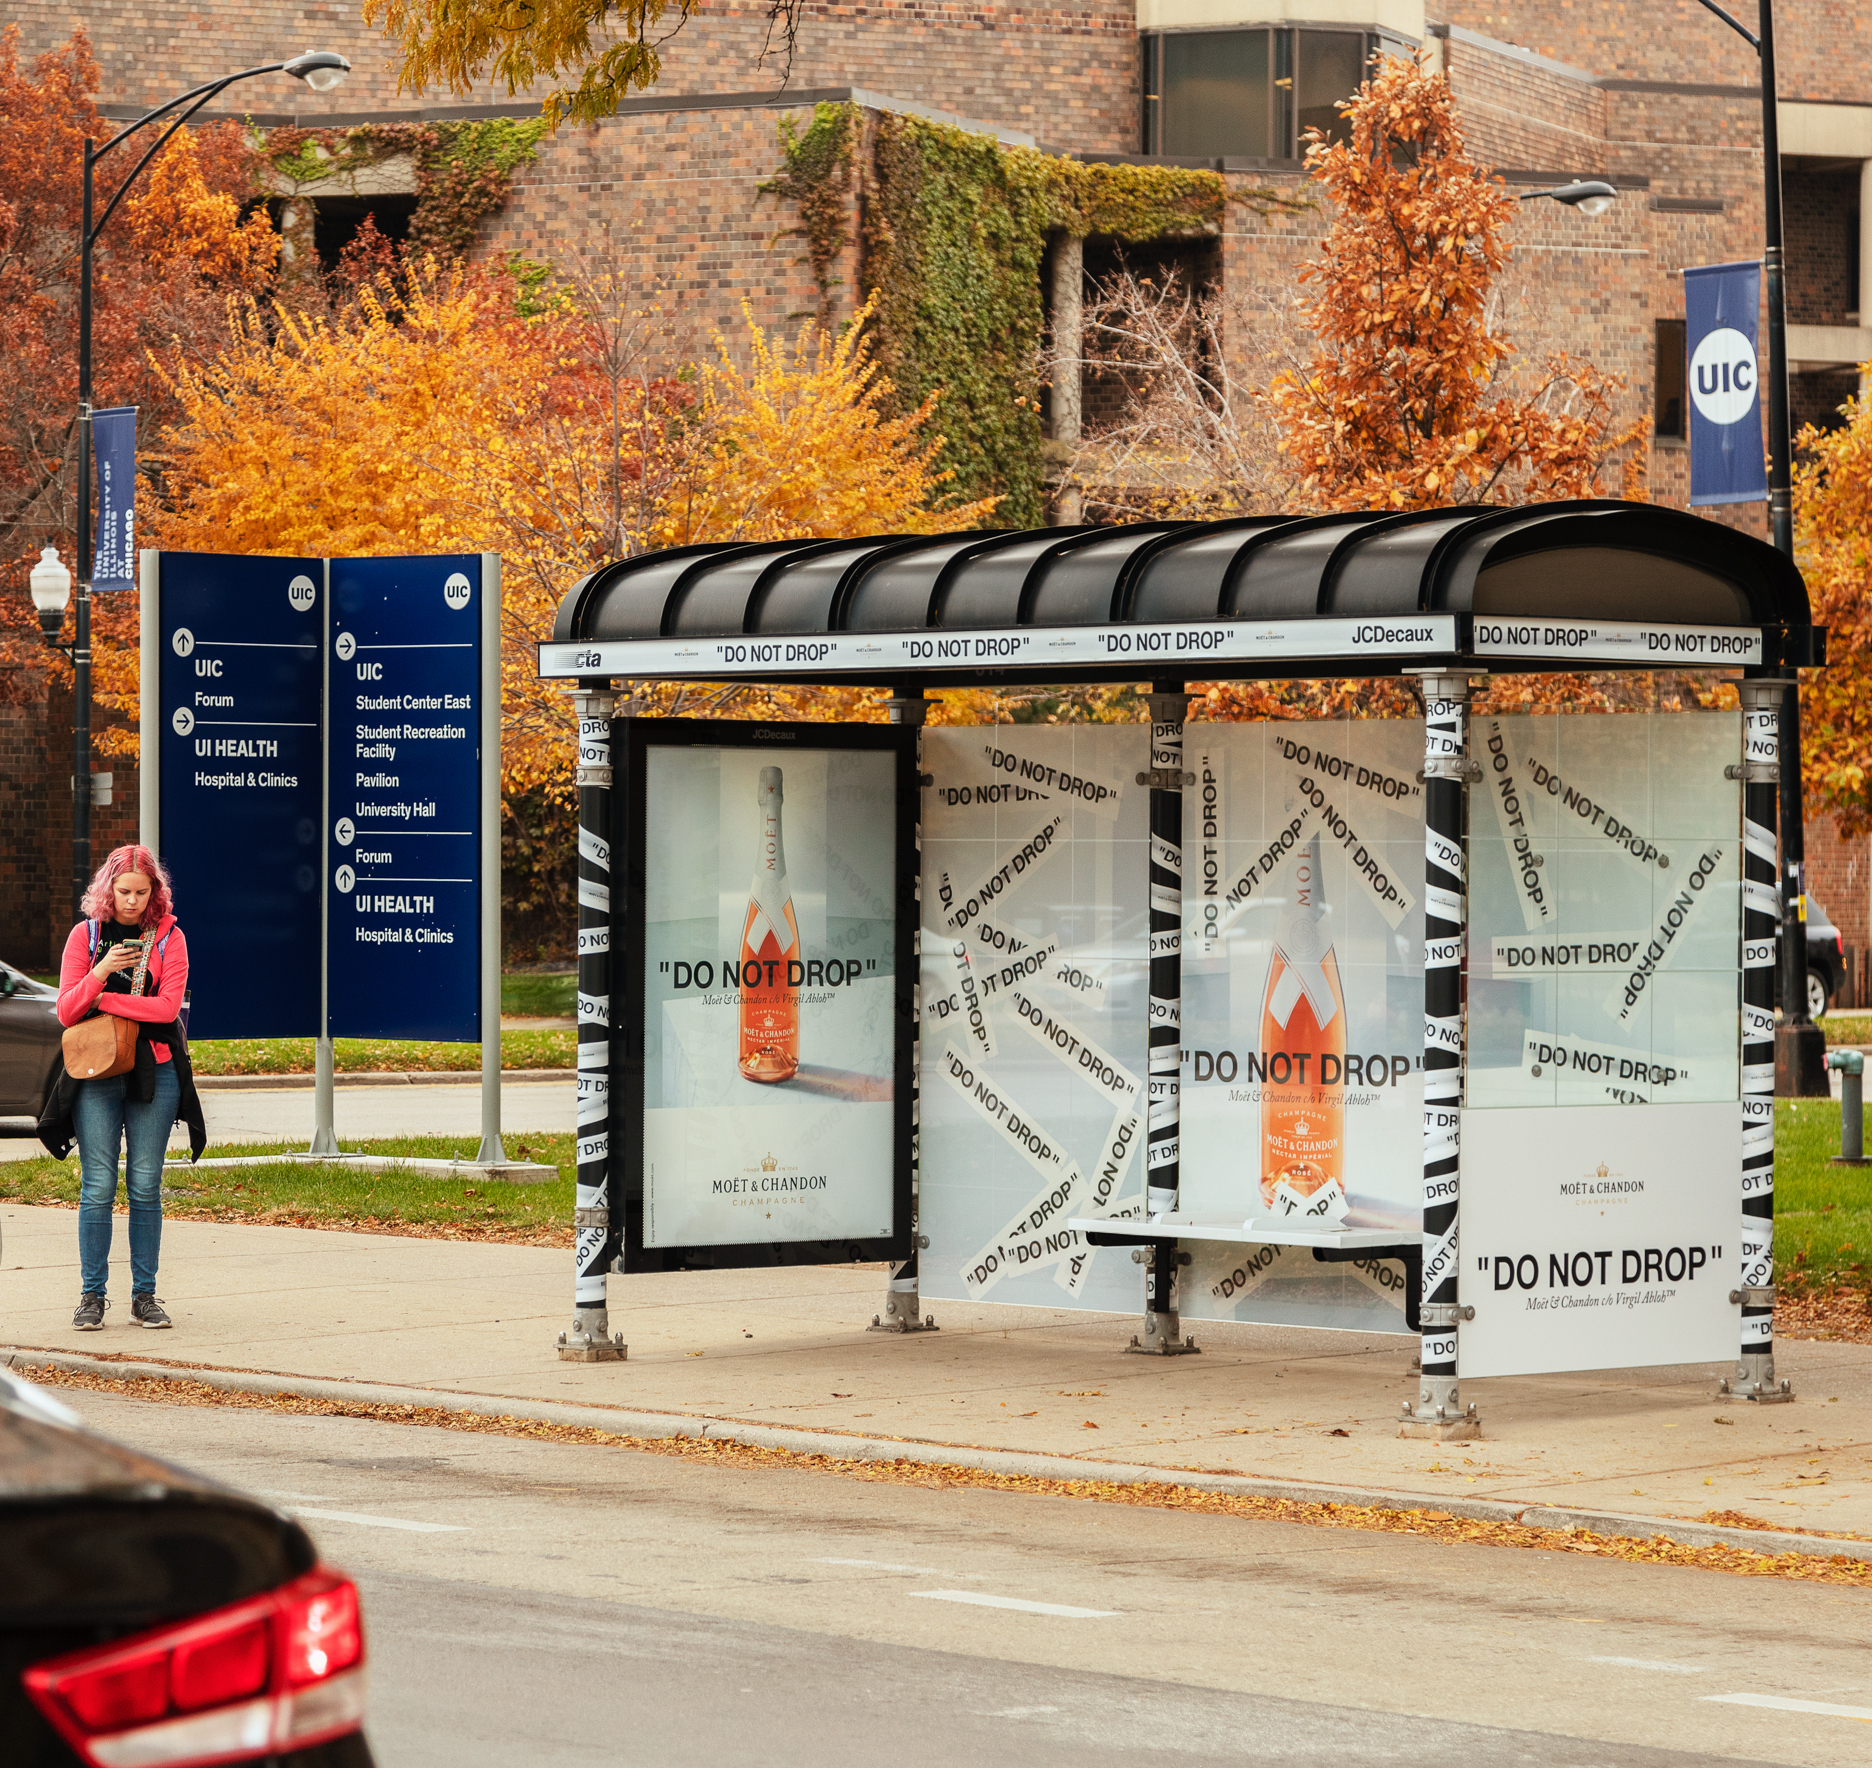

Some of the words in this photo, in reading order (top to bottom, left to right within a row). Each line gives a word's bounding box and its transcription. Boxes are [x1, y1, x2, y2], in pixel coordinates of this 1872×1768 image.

[1697, 360, 1752, 395] UIC
[104, 461, 111, 481] OF
[102, 485, 111, 579] UNIVERSITY
[125, 509, 134, 580] CHICAGO
[94, 550, 103, 580] THE
[117, 559, 124, 578] AT
[291, 587, 313, 600] UIC
[447, 585, 468, 598] UIC
[1098, 634, 1131, 652] "DO
[1137, 632, 1171, 651] NOT
[1176, 630, 1234, 650] DROP"
[1352, 625, 1434, 644] JCDecaux
[1507, 626, 1540, 645] NOT
[1544, 628, 1597, 647] DROP"
[1640, 632, 1671, 651] "DO
[1675, 634, 1706, 652] NOT
[1711, 635, 1760, 654] DROP"
[717, 645, 747, 662] "DO
[751, 644, 782, 662] NOT
[786, 643, 837, 661] DROP"
[902, 640, 933, 658] "DO
[938, 639, 971, 657] NOT
[975, 637, 1029, 656] DROP"
[195, 659, 223, 677] UIC
[356, 662, 383, 681] UIC
[195, 692, 234, 707] Forum
[356, 695, 401, 710] Student
[403, 695, 442, 710] Center
[444, 694, 471, 709] East
[356, 725, 401, 740] Student
[403, 724, 465, 739] Recreation
[752, 729, 796, 740] JCDecaux
[195, 738, 211, 757] UI
[215, 739, 278, 758] HEALTH
[356, 743, 396, 761] Facility
[985, 745, 1016, 773] "DO
[1020, 759, 1057, 786] NOT
[1058, 772, 1117, 803] DROP"
[1276, 736, 1311, 765] "DO
[1314, 751, 1354, 780] NOT
[1356, 766, 1420, 800] DROP"
[195, 771, 244, 790] Hospital
[247, 773, 256, 786] &
[258, 772, 298, 788] Clinics
[356, 773, 399, 787] Pavilion
[938, 786, 972, 806] "DO
[976, 784, 1011, 804] NOT
[1202, 756, 1217, 838] DROP"
[1528, 757, 1562, 796] "DO
[1562, 786, 1605, 826] NOT
[356, 802, 411, 820] University
[413, 802, 436, 816] Hall
[1487, 721, 1508, 773] "DO
[1498, 777, 1525, 829] NOT
[1513, 834, 1548, 917] DROP"
[765, 815, 777, 871] MOËT
[356, 848, 392, 863] Forum
[1225, 866, 1262, 911] NOT
[1258, 808, 1309, 874] DROP"
[1321, 804, 1358, 850] NOT
[1352, 846, 1406, 909] DROP"
[947, 898, 979, 928] "DO
[979, 865, 1012, 906] NOT
[1011, 816, 1061, 874] DROP"
[1203, 844, 1218, 896] NOT
[1688, 849, 1723, 891] "DO
[356, 895, 371, 912] UI
[374, 896, 434, 913] HEALTH
[1204, 903, 1219, 952] "DO
[1659, 891, 1694, 944] NOT
[356, 927, 402, 945] Hospital
[404, 928, 413, 942] &
[415, 928, 454, 943] Clinics
[1001, 945, 1055, 987] DROP"
[1496, 947, 1535, 967] "DO
[1542, 944, 1583, 966] NOT
[659, 960, 714, 989] "DO
[723, 960, 779, 988] NOT
[787, 959, 876, 988] DROP"
[1620, 940, 1665, 1020] DROP"
[702, 995, 721, 1005] Moët
[733, 993, 767, 1004] Chandon
[769, 994, 780, 1004] c/o
[782, 993, 804, 1007] Virgil
[752, 1009, 787, 1017] CHAMPAGNE
[960, 975, 991, 1053] DROP"
[765, 1027, 795, 1038] CHANDON
[1013, 992, 1043, 1027] "DO
[1043, 1018, 1080, 1056] NOT
[1078, 1047, 1134, 1093] DROP"
[1179, 1050, 1238, 1083] "DO
[1248, 1051, 1312, 1085] NOT
[1528, 1041, 1567, 1067] "DO
[1572, 1050, 1615, 1076] NOT
[1619, 1058, 1688, 1087] DROP"
[946, 1051, 974, 1088] "DO
[974, 1081, 1009, 1120] NOT
[1006, 1113, 1060, 1164] DROP"
[1228, 1089, 1251, 1102] Moët
[1252, 1089, 1261, 1102] &
[1262, 1090, 1302, 1104] Chandon
[1303, 1091, 1316, 1104] c/o
[1317, 1092, 1343, 1109] Virgil
[1278, 1110, 1327, 1122] CHAMPAGNE
[1111, 1118, 1138, 1160] "DO
[1267, 1133, 1288, 1149] MOËT
[1290, 1142, 1295, 1150] &
[1296, 1138, 1338, 1152] CHANDON
[1271, 1148, 1297, 1159] NECTAR
[712, 1177, 748, 1194] MOËT
[751, 1180, 758, 1192] &
[761, 1176, 827, 1192] CHANDON
[1560, 1181, 1588, 1195] MOËT
[1589, 1184, 1595, 1194] &
[1596, 1180, 1645, 1193] CHANDON
[732, 1197, 805, 1206] CHAMPAGNE
[1029, 1172, 1078, 1228] DROP"
[1575, 1197, 1628, 1206] CHAMPAGNE
[1008, 1240, 1042, 1264] "DO
[1045, 1229, 1079, 1255] NOT
[967, 1255, 998, 1285] "DO
[1478, 1254, 1539, 1291] "DO
[1549, 1251, 1613, 1288] NOT
[1621, 1245, 1722, 1284] DROP"
[1211, 1268, 1246, 1299] "DO
[1525, 1296, 1548, 1311] Moët
[1550, 1295, 1561, 1309] &
[1561, 1295, 1600, 1309] Chandon
[1601, 1293, 1613, 1306] c/o
[1616, 1291, 1641, 1309] Virgil
[1425, 1340, 1456, 1356] "DO
